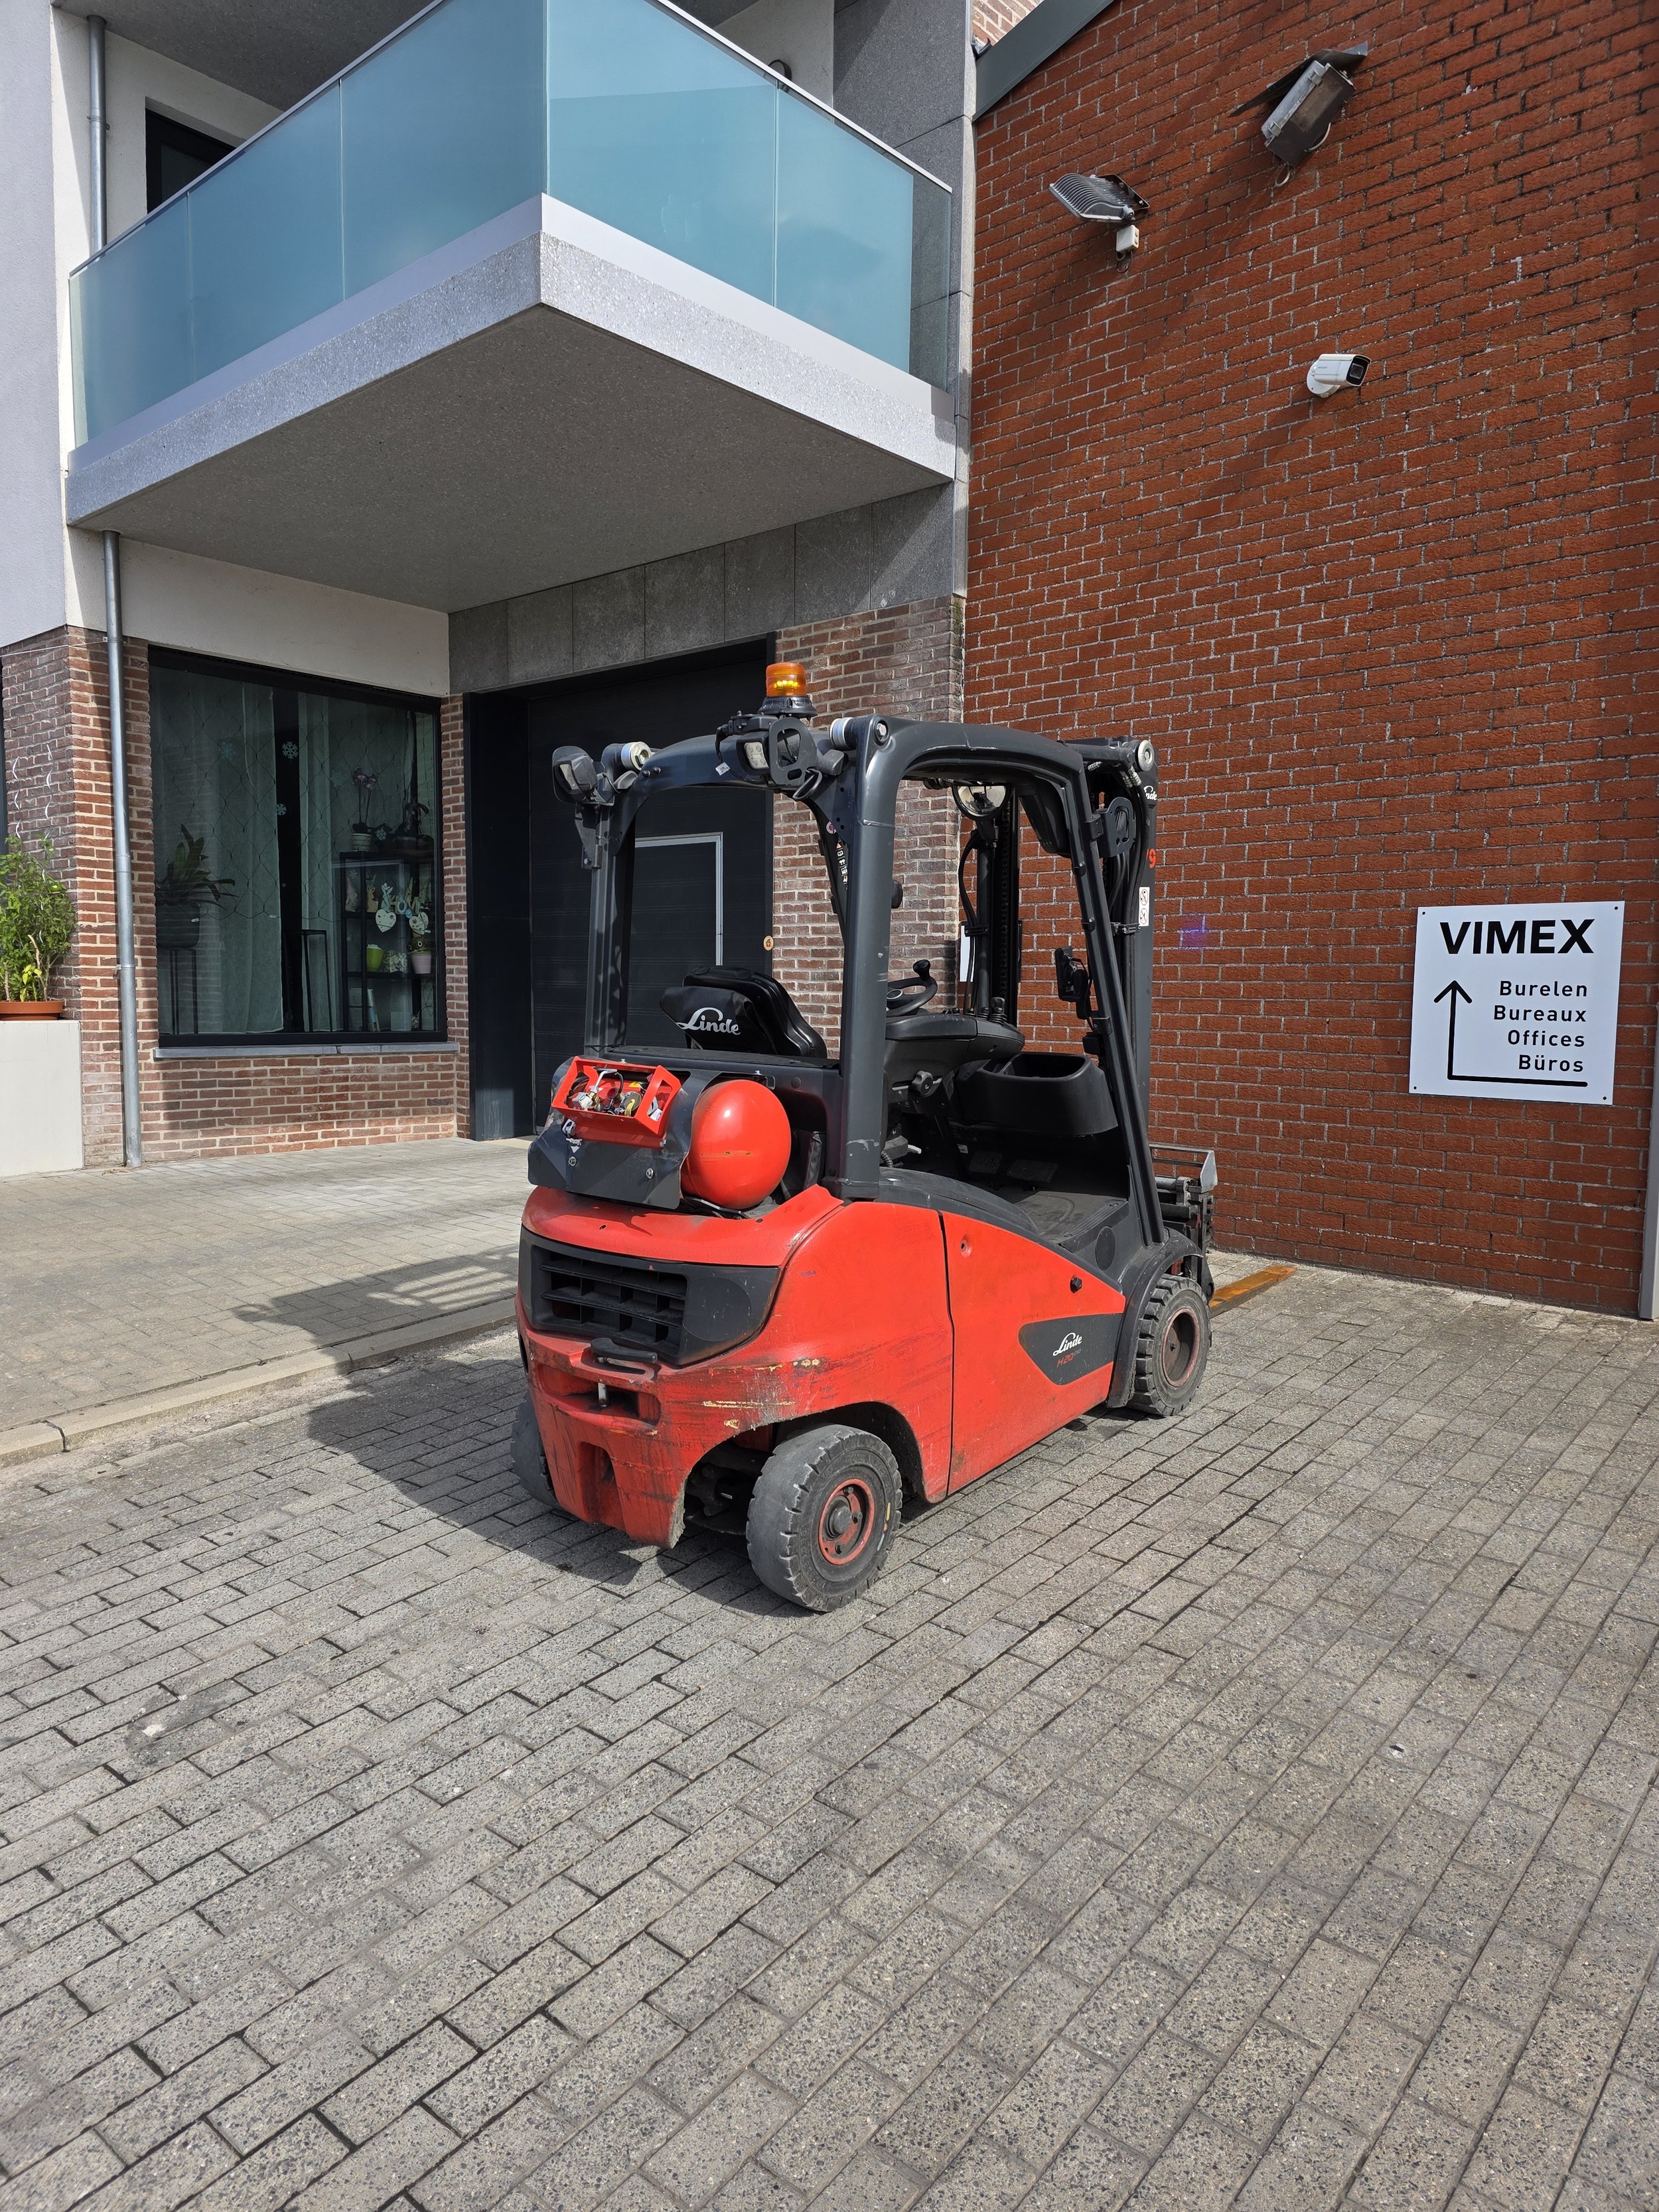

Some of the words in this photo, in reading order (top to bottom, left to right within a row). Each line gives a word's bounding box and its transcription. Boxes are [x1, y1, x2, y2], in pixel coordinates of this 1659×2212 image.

[1143, 785, 1157, 800] nde
[1146, 849, 1156, 869] 9
[1439, 919, 1595, 954] VIMEX
[1499, 980, 1587, 997] Burelen
[675, 1007, 741, 1035] Linde
[1494, 1005, 1587, 1022] Bureaux
[1508, 1029, 1585, 1047] Offices
[1518, 1054, 1584, 1072] Büros
[1052, 1332, 1082, 1356] Linde
